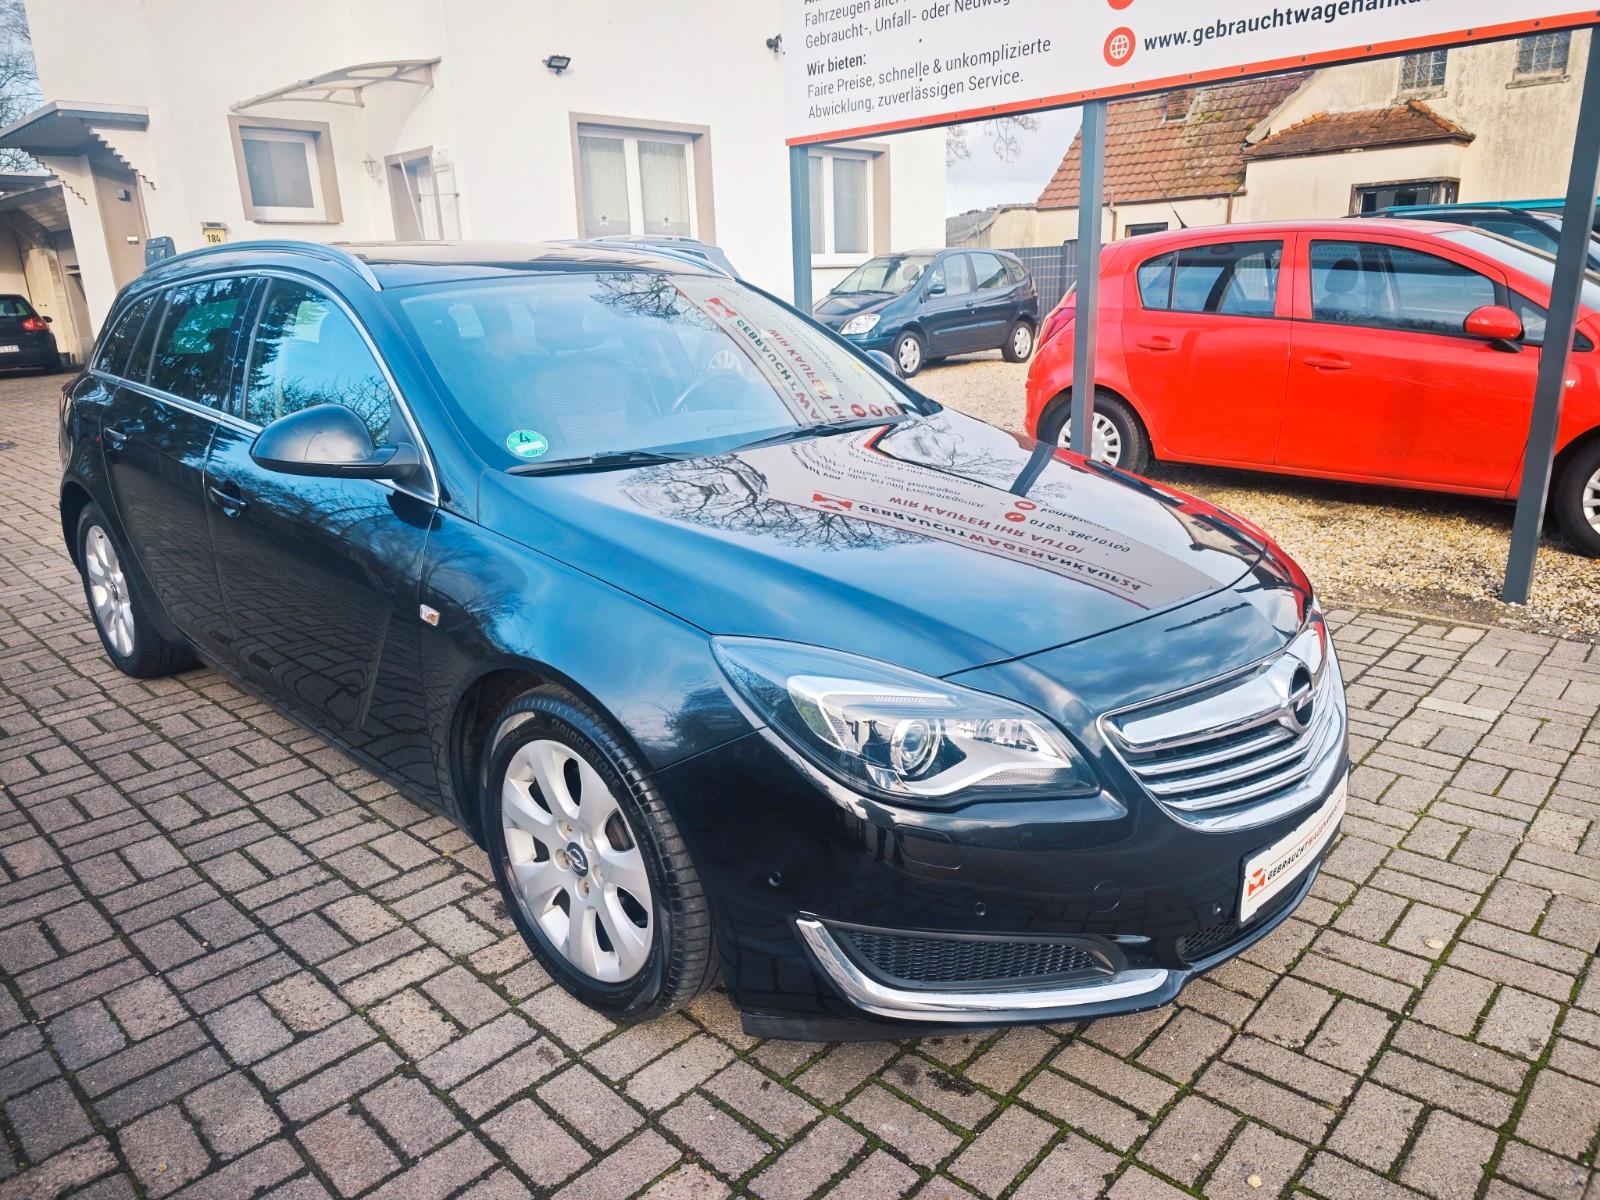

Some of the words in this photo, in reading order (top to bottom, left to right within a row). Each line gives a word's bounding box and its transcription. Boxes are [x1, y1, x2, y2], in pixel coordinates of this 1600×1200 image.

[805, 1, 870, 27] Fahrzeugen
[806, 23, 872, 48] Gebraucht-,
[875, 9, 917, 31] Unfall-
[921, 3, 950, 20] oder
[955, 0, 1011, 13] Neuw
[807, 62, 825, 76] Wir
[828, 54, 867, 72] bieten:
[808, 82, 834, 98] Faire
[837, 75, 875, 93] Preise,
[880, 61, 930, 85] schnelle
[933, 58, 942, 74] &
[946, 39, 1051, 71] unkomplizierte
[808, 98, 875, 119] Abwicklung,
[878, 81, 964, 107] zuverlässigen
[968, 69, 1024, 91] Service.
